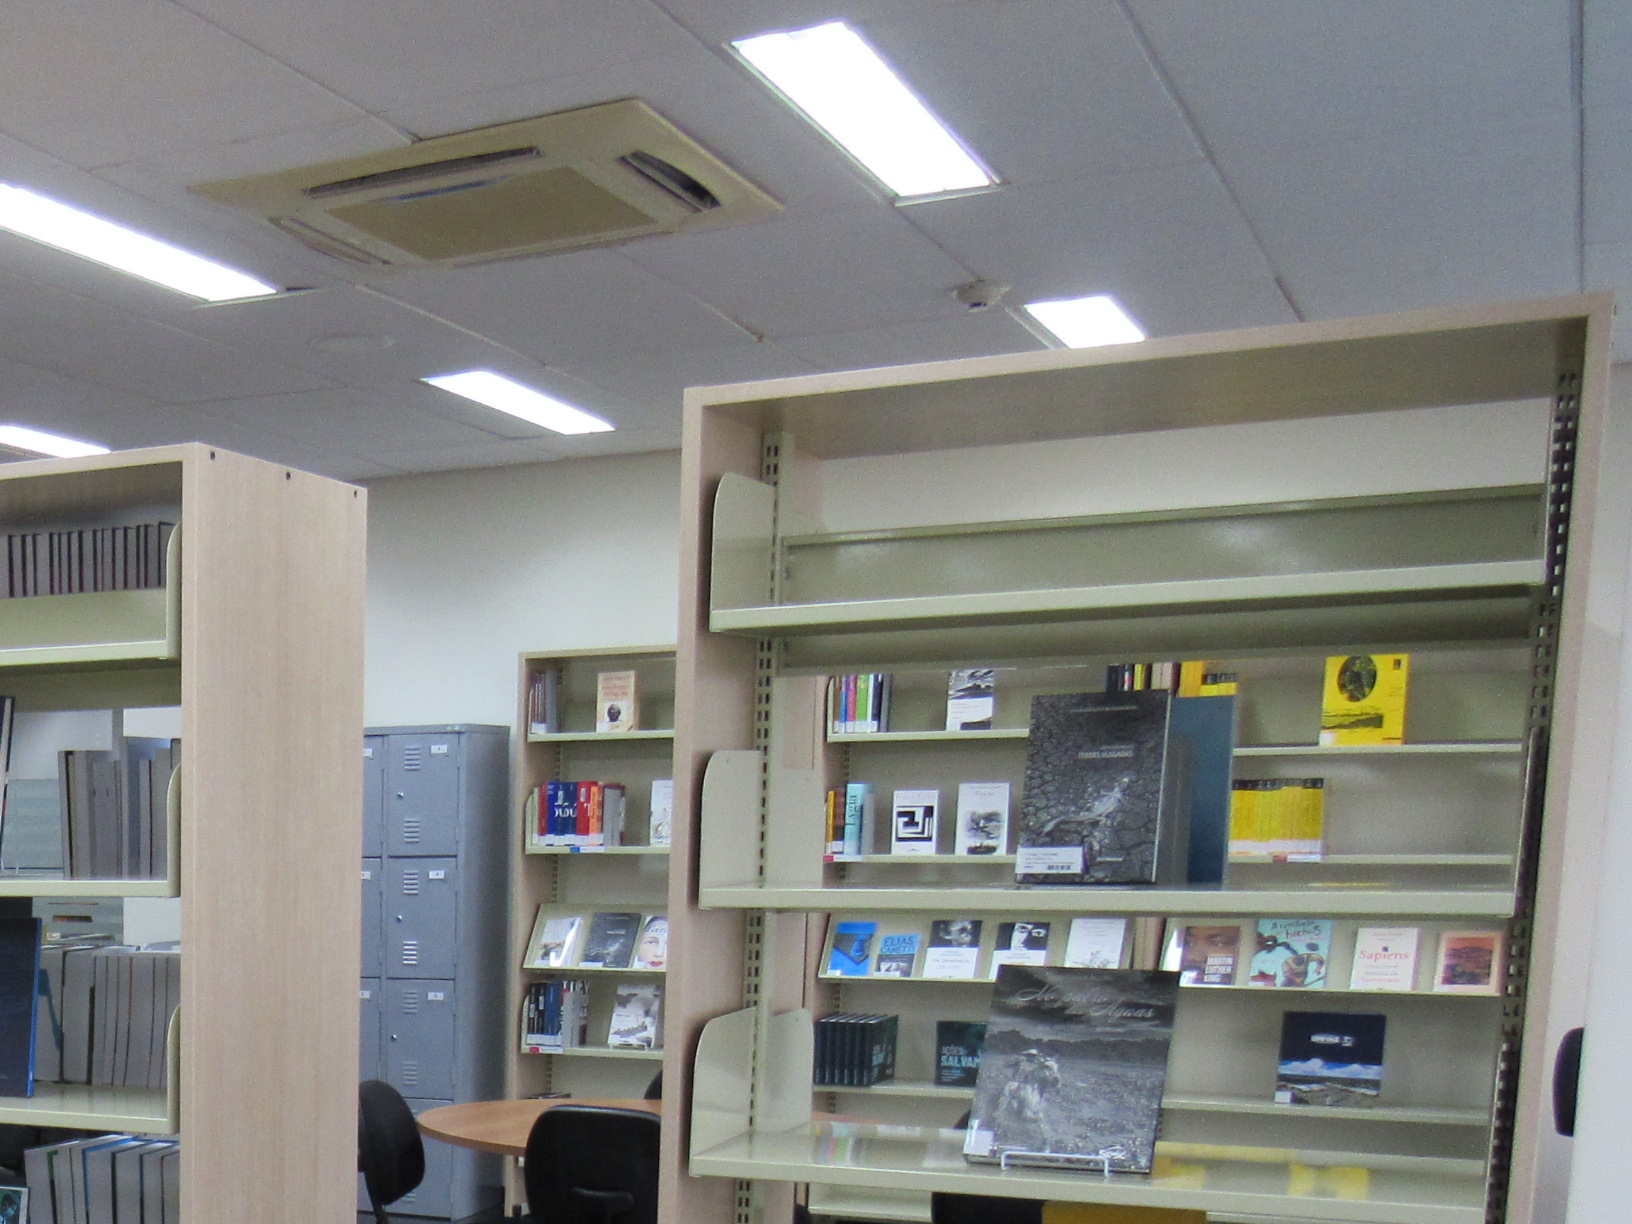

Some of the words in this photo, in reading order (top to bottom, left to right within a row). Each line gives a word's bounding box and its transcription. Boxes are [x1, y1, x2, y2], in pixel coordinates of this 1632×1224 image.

[882, 936, 914, 947] ELIAS
[1358, 947, 1409, 964] Sapiens
[1203, 974, 1222, 984] KING
